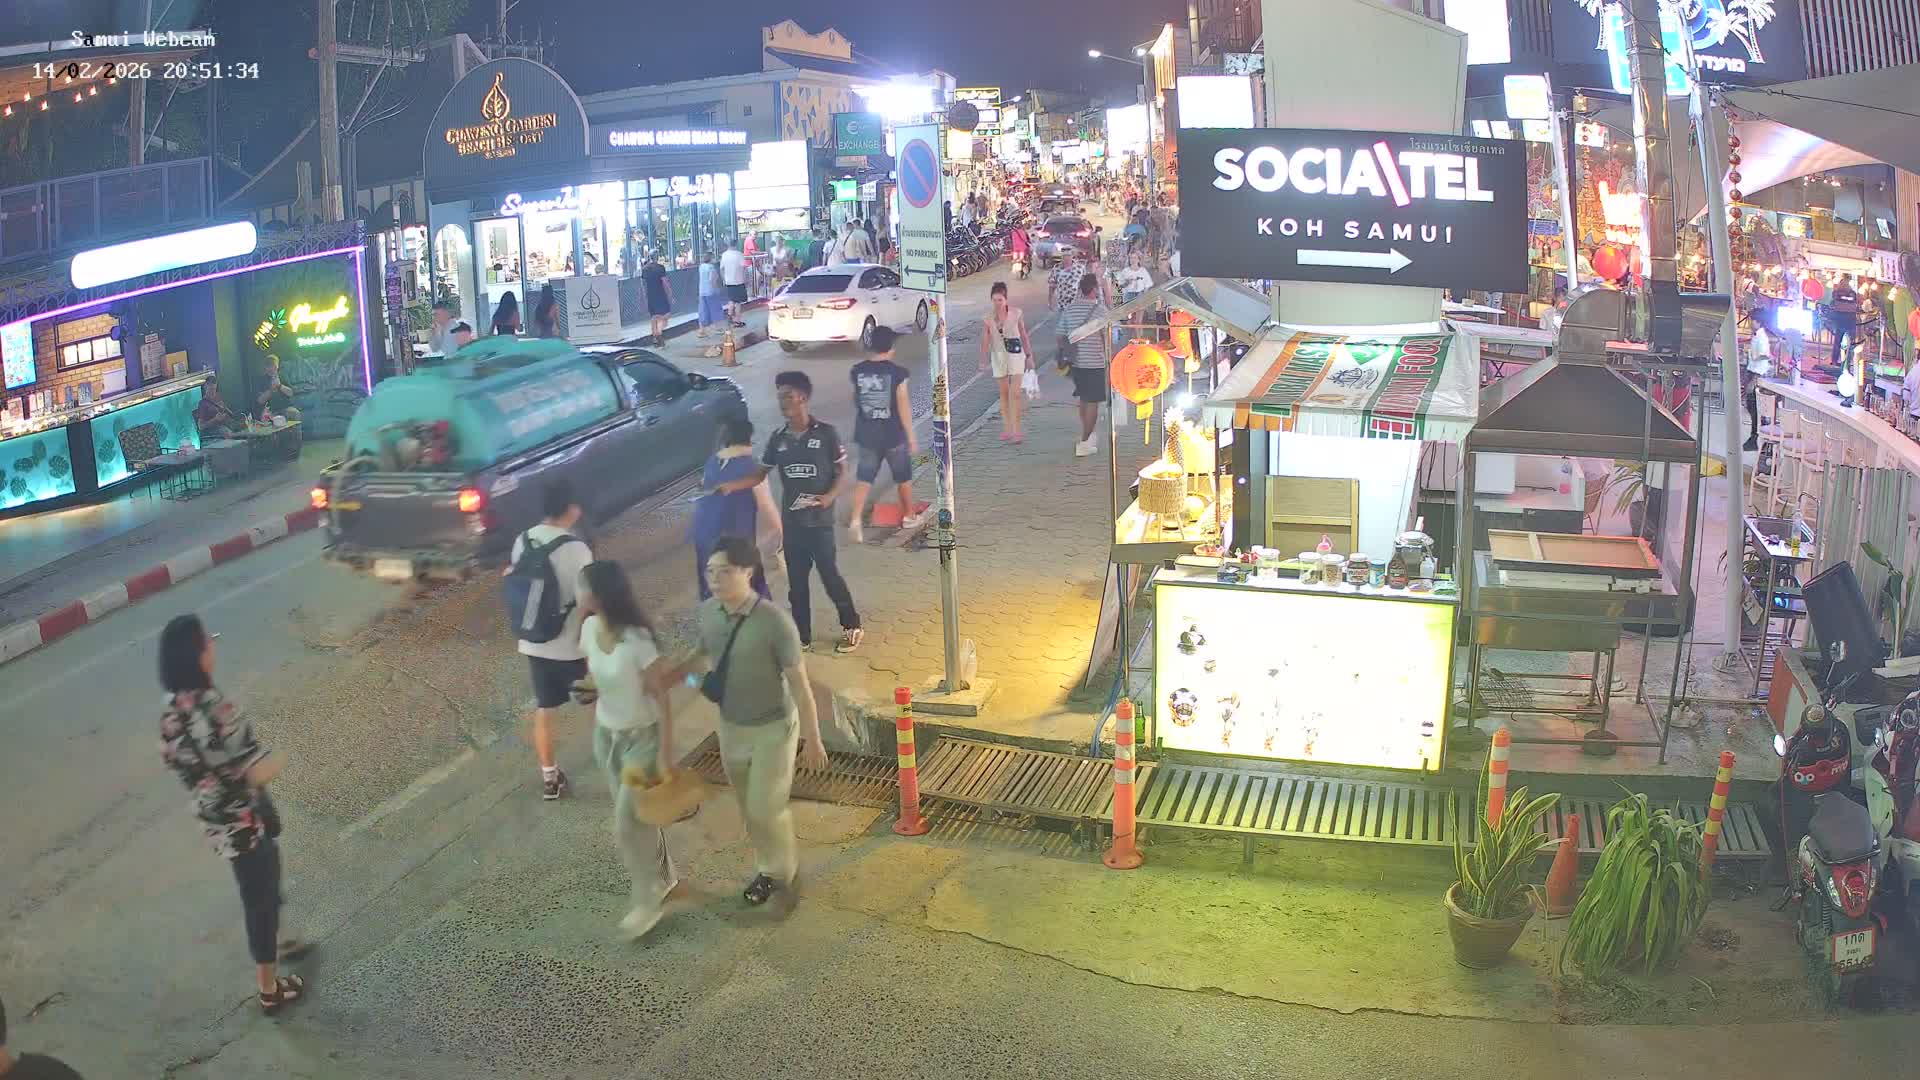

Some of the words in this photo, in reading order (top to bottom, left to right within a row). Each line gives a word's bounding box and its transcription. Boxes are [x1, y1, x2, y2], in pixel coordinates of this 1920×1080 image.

[839, 140, 879, 150] EXCHANGE
[1257, 217, 1324, 237] KOH
[1344, 220, 1452, 244] SAMUI
[906, 249, 914, 257] NO
[914, 249, 938, 259] PARKING
